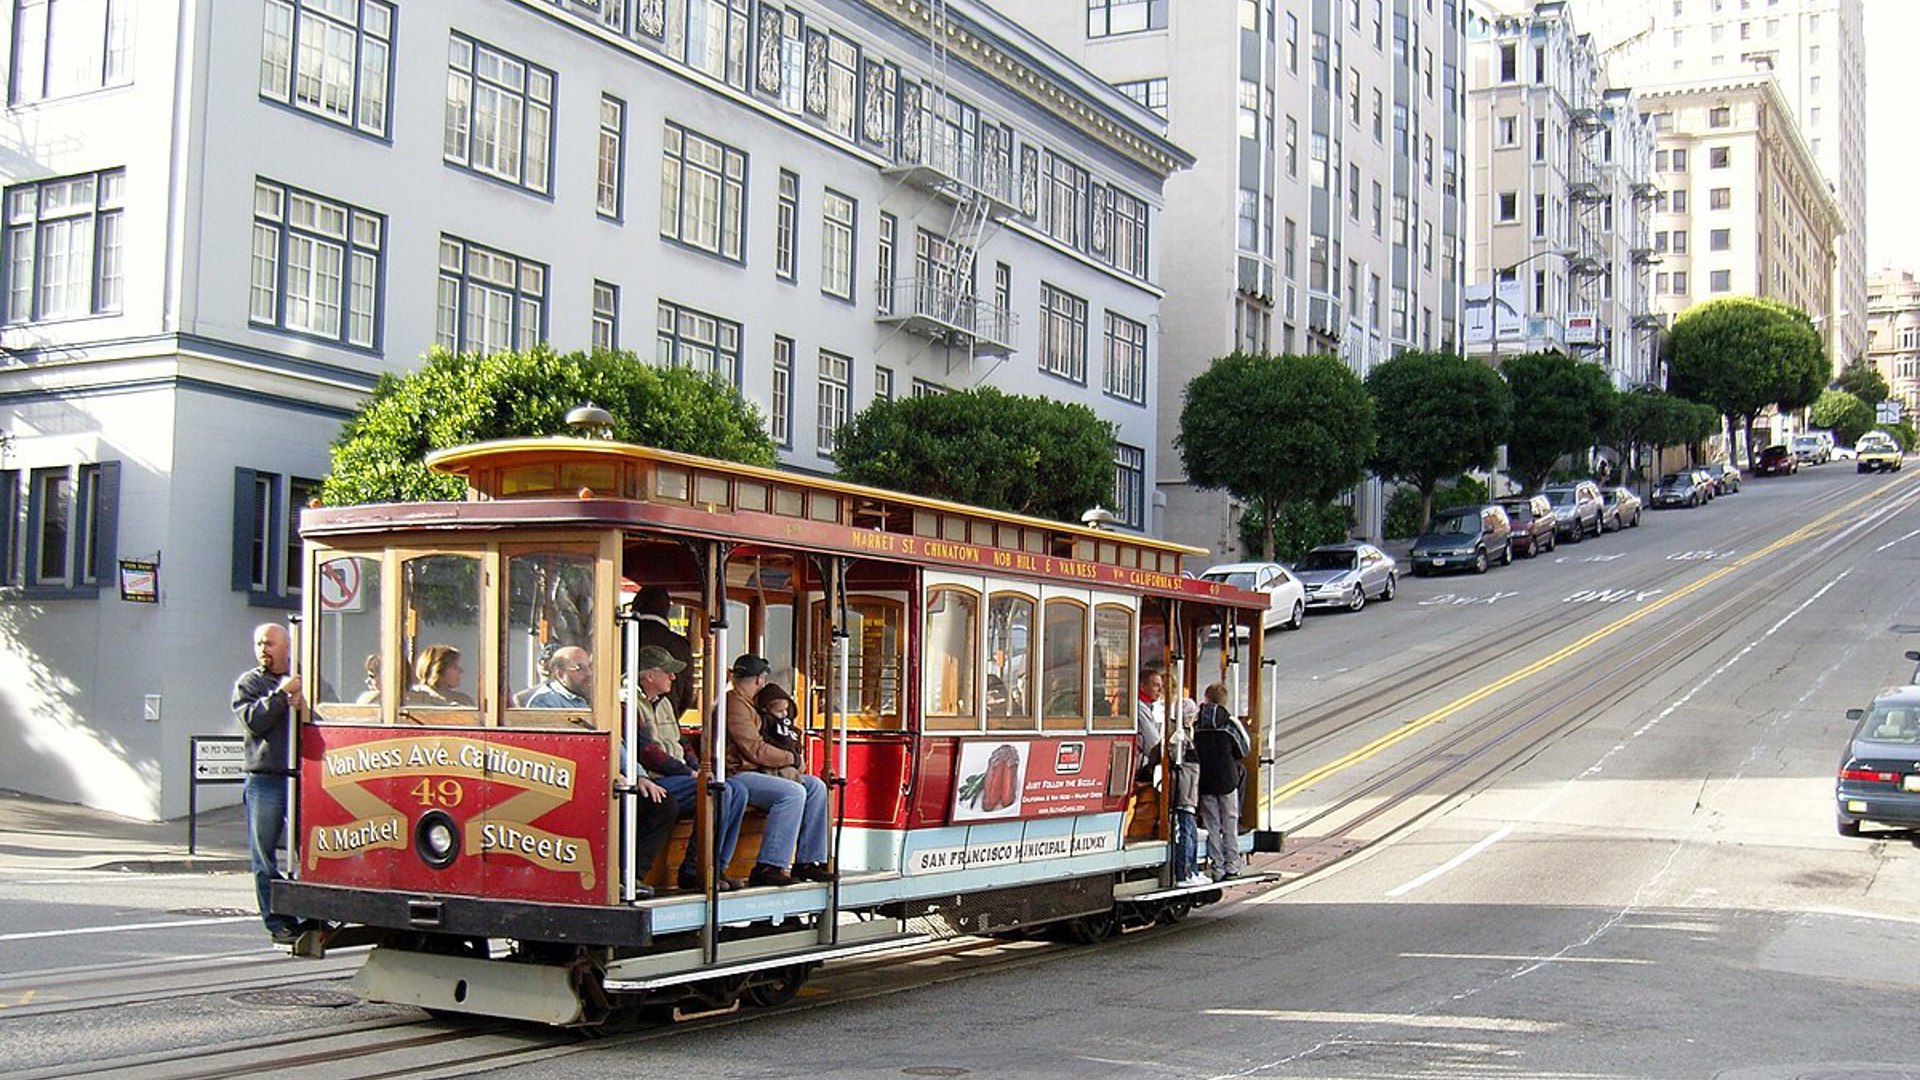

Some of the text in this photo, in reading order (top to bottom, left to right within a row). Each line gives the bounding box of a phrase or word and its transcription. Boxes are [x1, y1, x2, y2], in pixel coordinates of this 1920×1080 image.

[851, 531, 894, 551] MARKET
[901, 538, 916, 554] ST.
[924, 541, 980, 562] CHINATOWN
[993, 551, 1011, 567] NOB
[1017, 555, 1036, 570] HILL
[1059, 560, 1075, 576] VAN
[1077, 563, 1097, 579] NESS
[1130, 572, 1172, 589] CALIFORNIA
[1209, 584, 1220, 595] 49
[325, 753, 356, 777] Van
[356, 748, 403, 772] Ness
[459, 744, 571, 789] California
[411, 777, 463, 807] 49
[1025, 781, 1041, 790] JUST
[317, 817, 399, 851] & Market
[481, 824, 578, 864] Streets
[921, 836, 1106, 869] SAN FRANCISCO MUNICIPAL RAILWAY
